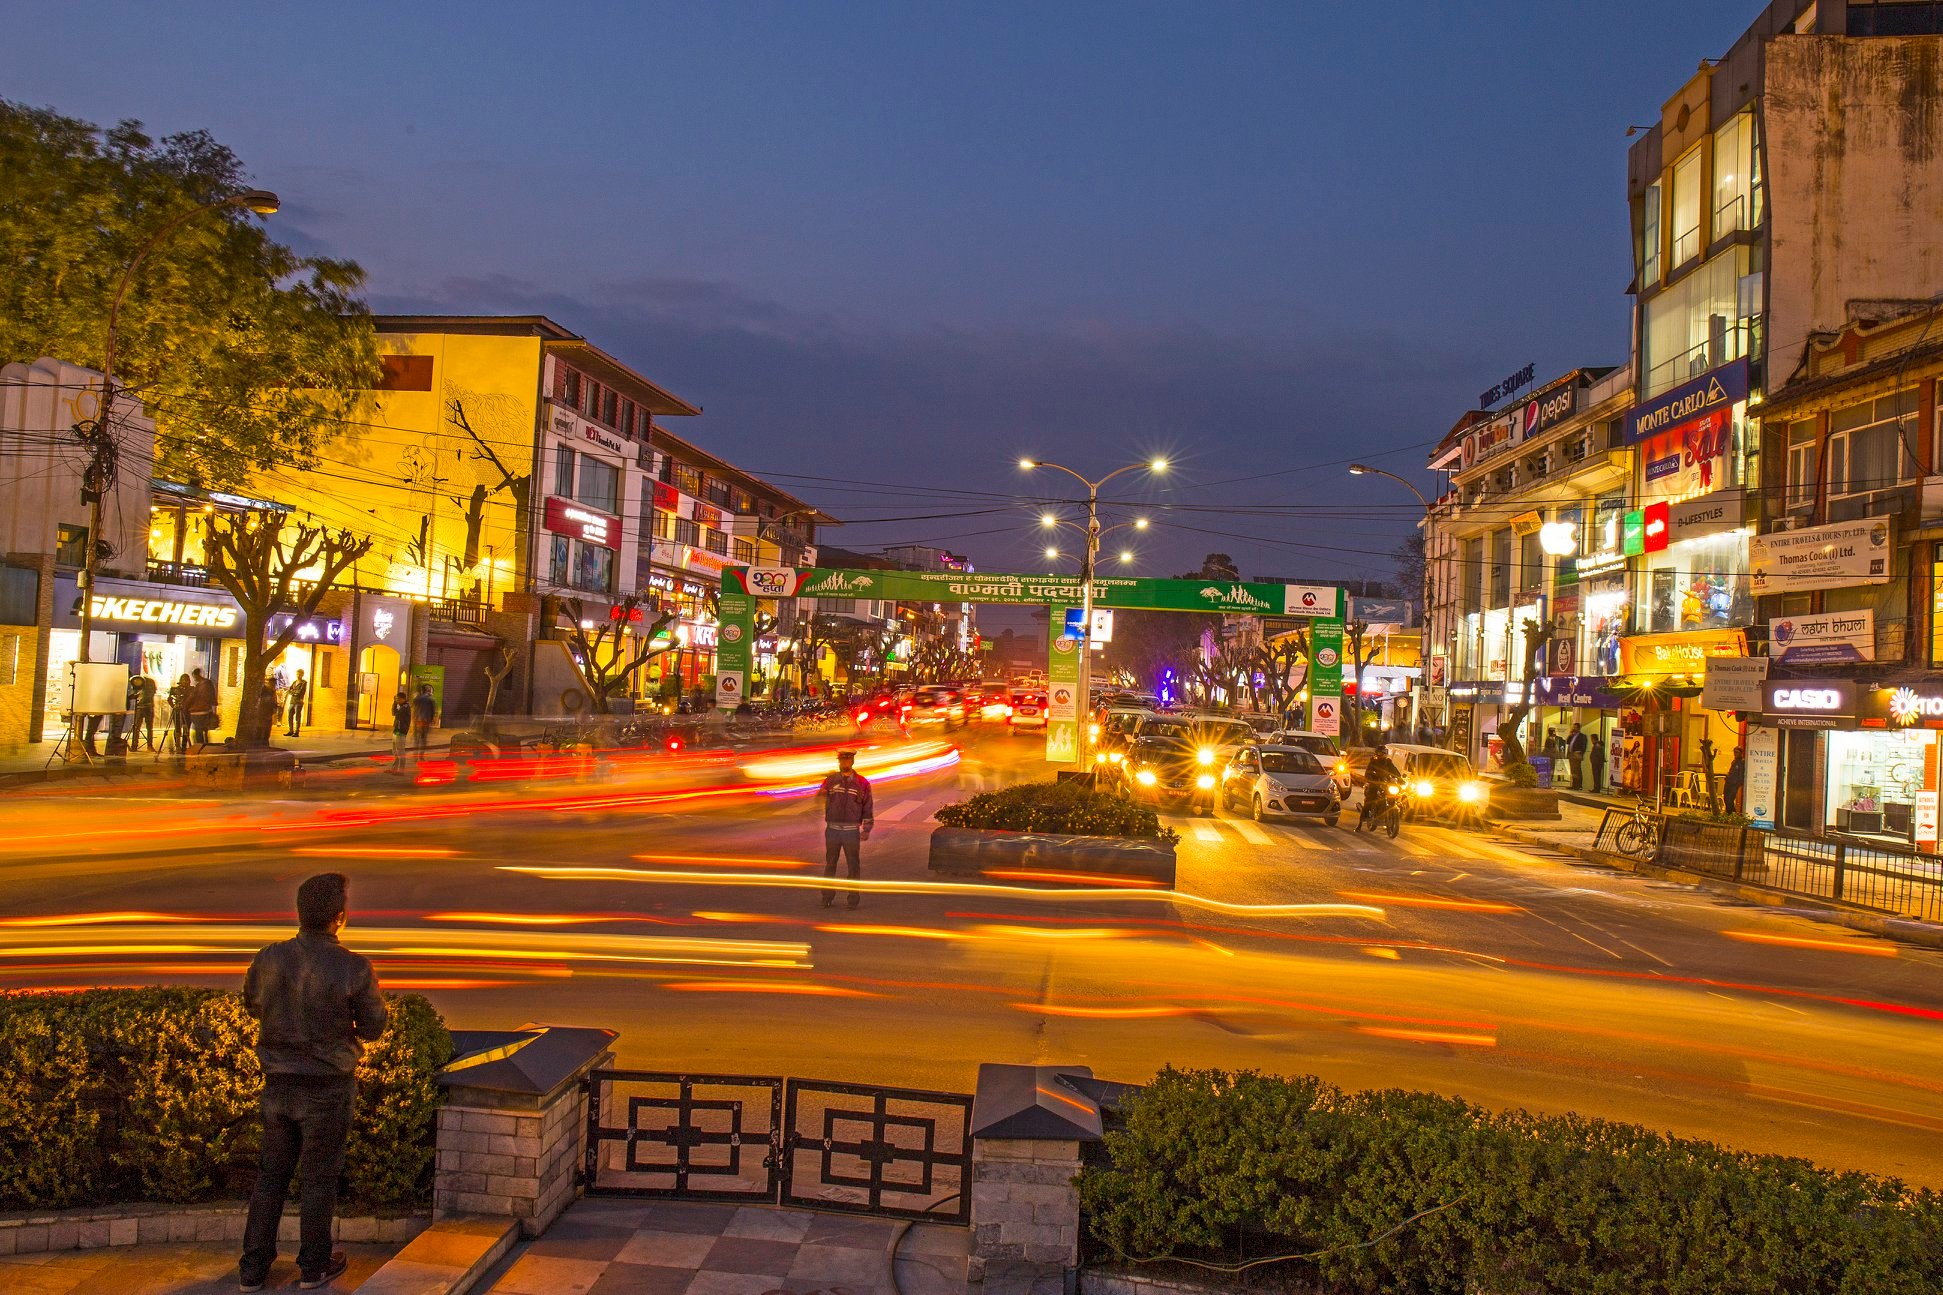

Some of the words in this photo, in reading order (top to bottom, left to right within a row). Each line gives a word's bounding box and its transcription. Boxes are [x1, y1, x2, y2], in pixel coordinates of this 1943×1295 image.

[1479, 385, 1501, 409] TIMES
[1502, 362, 1536, 396] SQUARE
[1540, 385, 1572, 428] pepsi
[1635, 405, 1670, 435] MONTE
[1671, 390, 1706, 420] CARLO
[1685, 423, 1727, 468] Sale
[1677, 507, 1724, 528] D-LIFESTYLES
[1770, 538, 1791, 548] ENTIRE
[1792, 534, 1816, 545] TRAVELS
[1822, 531, 1842, 541] TOURS
[1779, 552, 1808, 565] Thomas
[1809, 549, 1828, 562] Cook
[1839, 546, 1856, 558] Ltd.
[1754, 578, 1766, 586] IATA
[79, 596, 238, 628] SKECHERS
[694, 626, 715, 646] KFC
[1773, 689, 1841, 709] CASIO
[1777, 718, 1797, 726] ACHIEVE
[1797, 719, 1837, 727] INTERNATIONAL
[1749, 749, 1776, 758] ENTIRE
